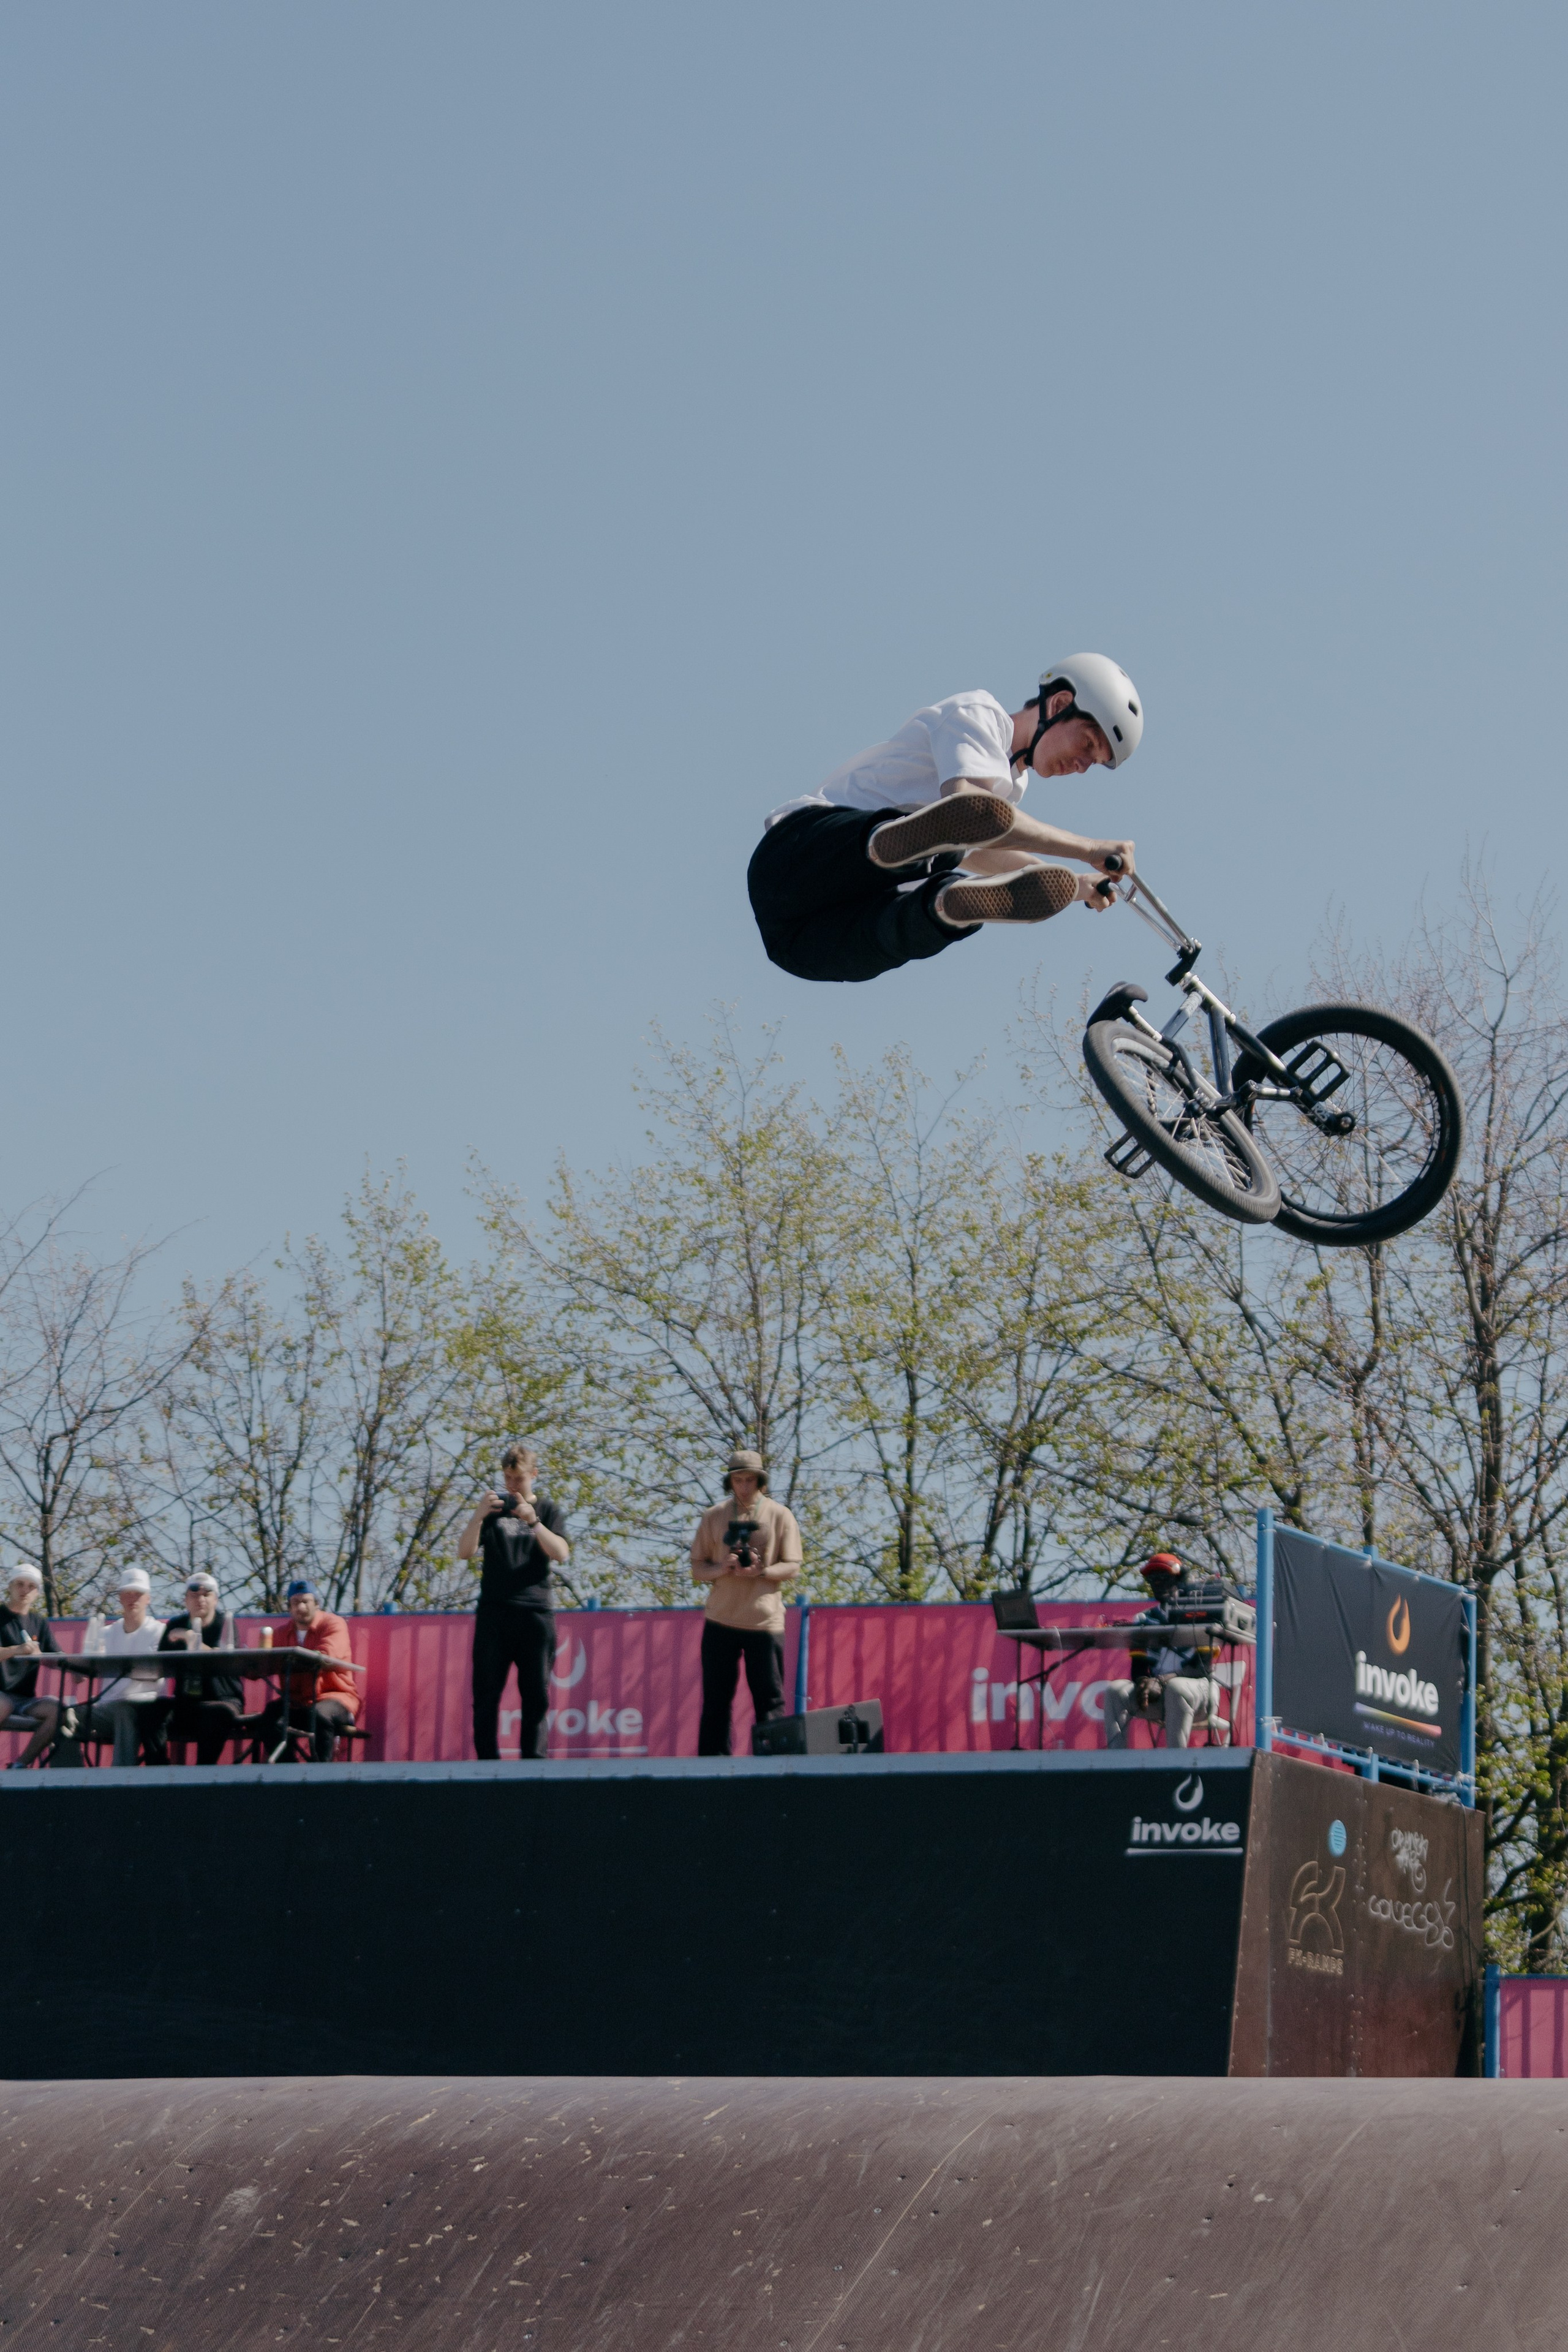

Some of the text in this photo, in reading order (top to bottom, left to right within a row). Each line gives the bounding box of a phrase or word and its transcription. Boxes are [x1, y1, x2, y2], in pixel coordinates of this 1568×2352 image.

[972, 1667, 1112, 1721] invo
[1355, 1650, 1439, 1716] invoke
[500, 1699, 644, 1736] noke
[1132, 1816, 1241, 1842] invoke
